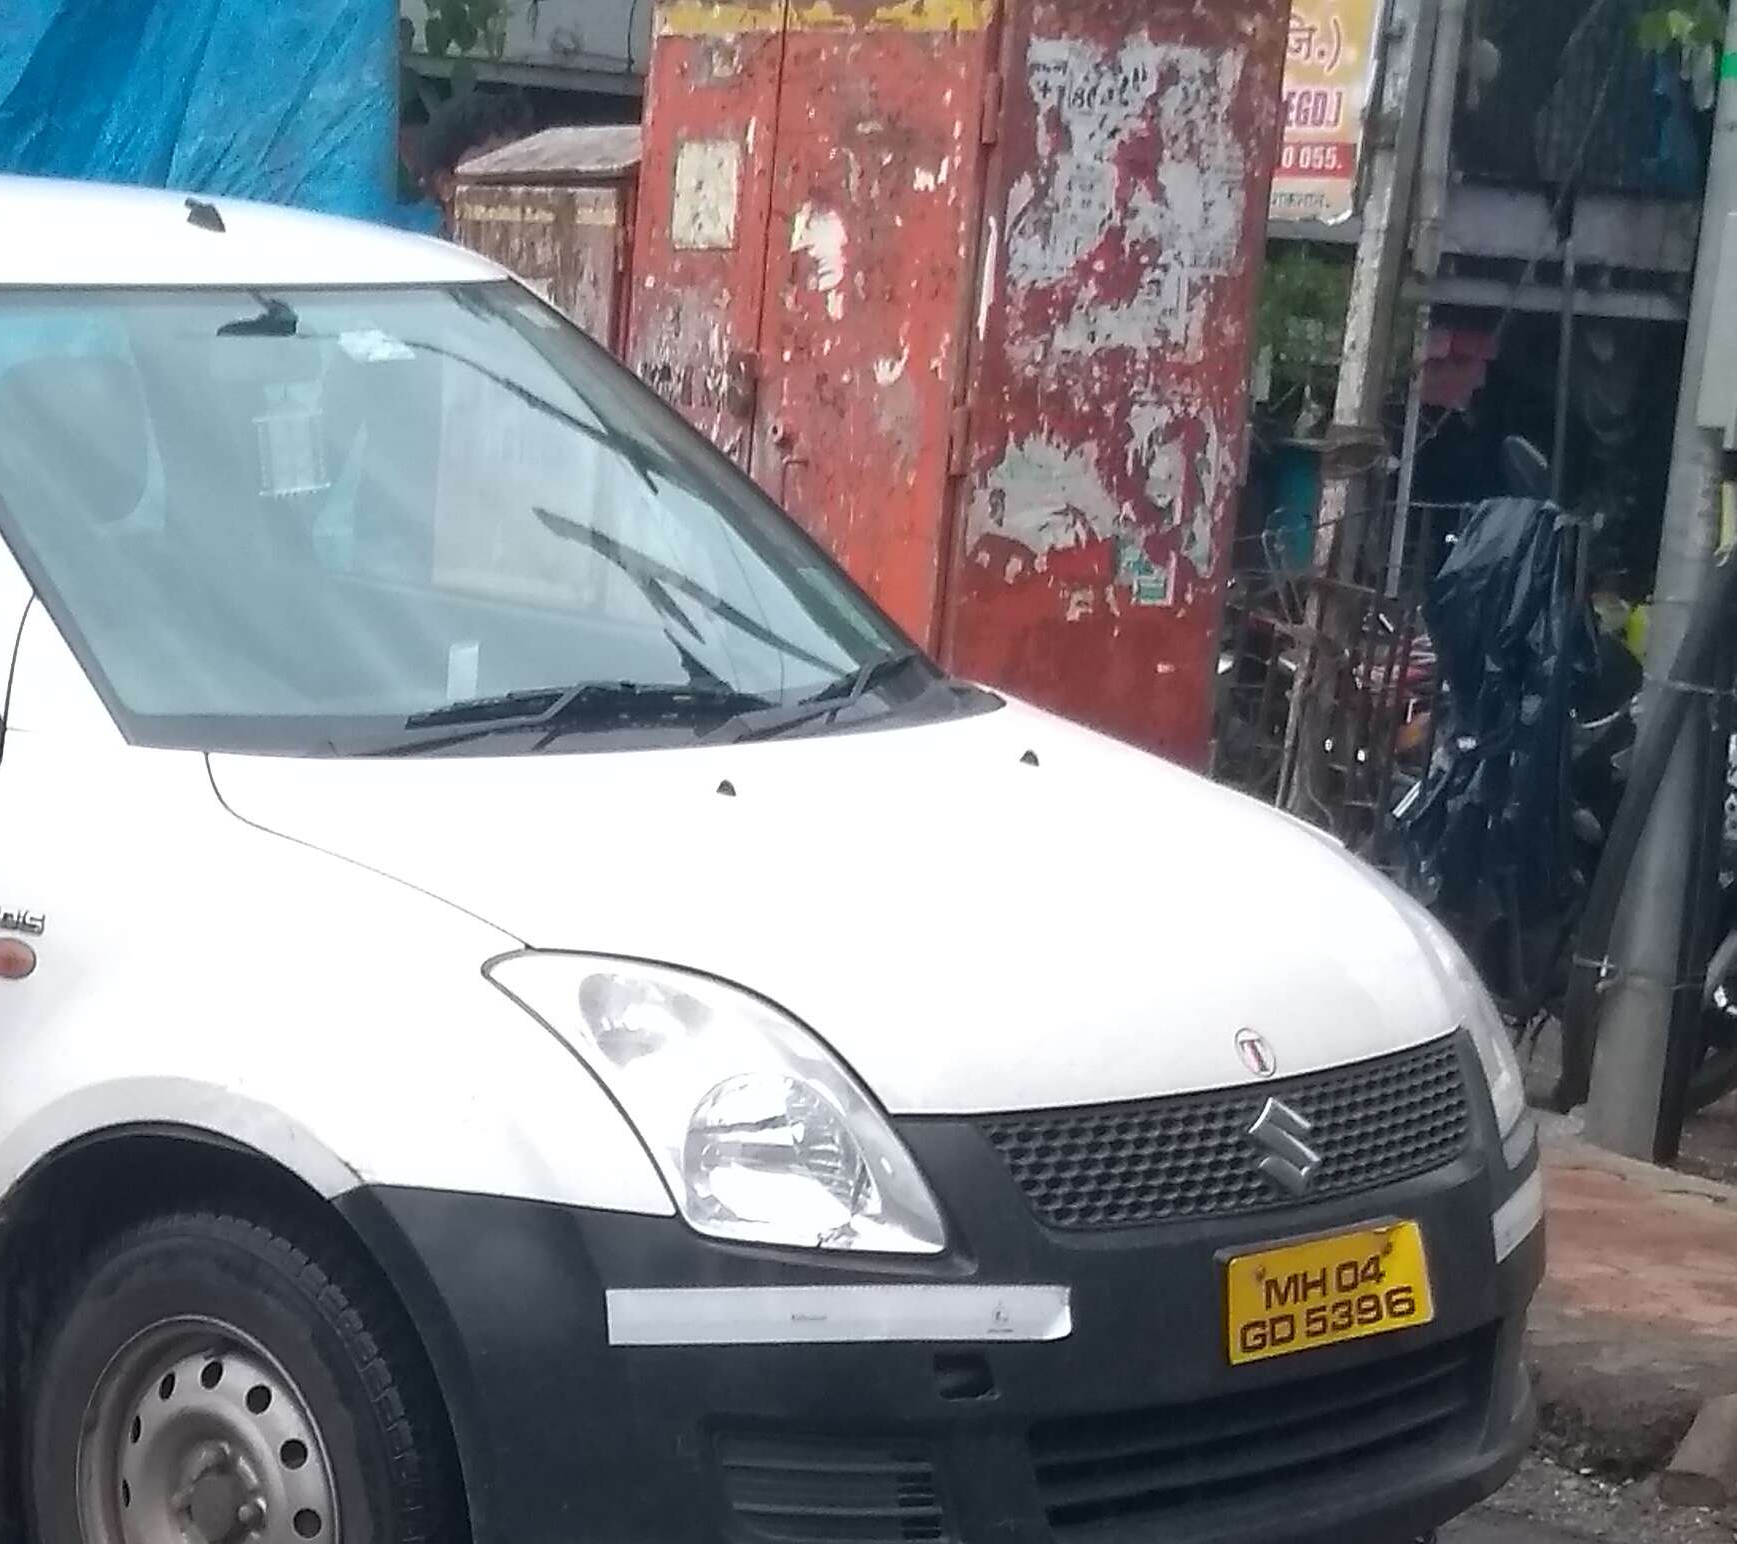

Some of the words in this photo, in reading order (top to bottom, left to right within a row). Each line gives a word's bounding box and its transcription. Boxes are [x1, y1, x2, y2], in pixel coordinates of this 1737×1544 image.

[1265, 1267, 1327, 1311] MH
[1334, 1254, 1386, 1293] 04
[1240, 1313, 1295, 1353] GD
[1305, 1285, 1416, 1338] 5396
